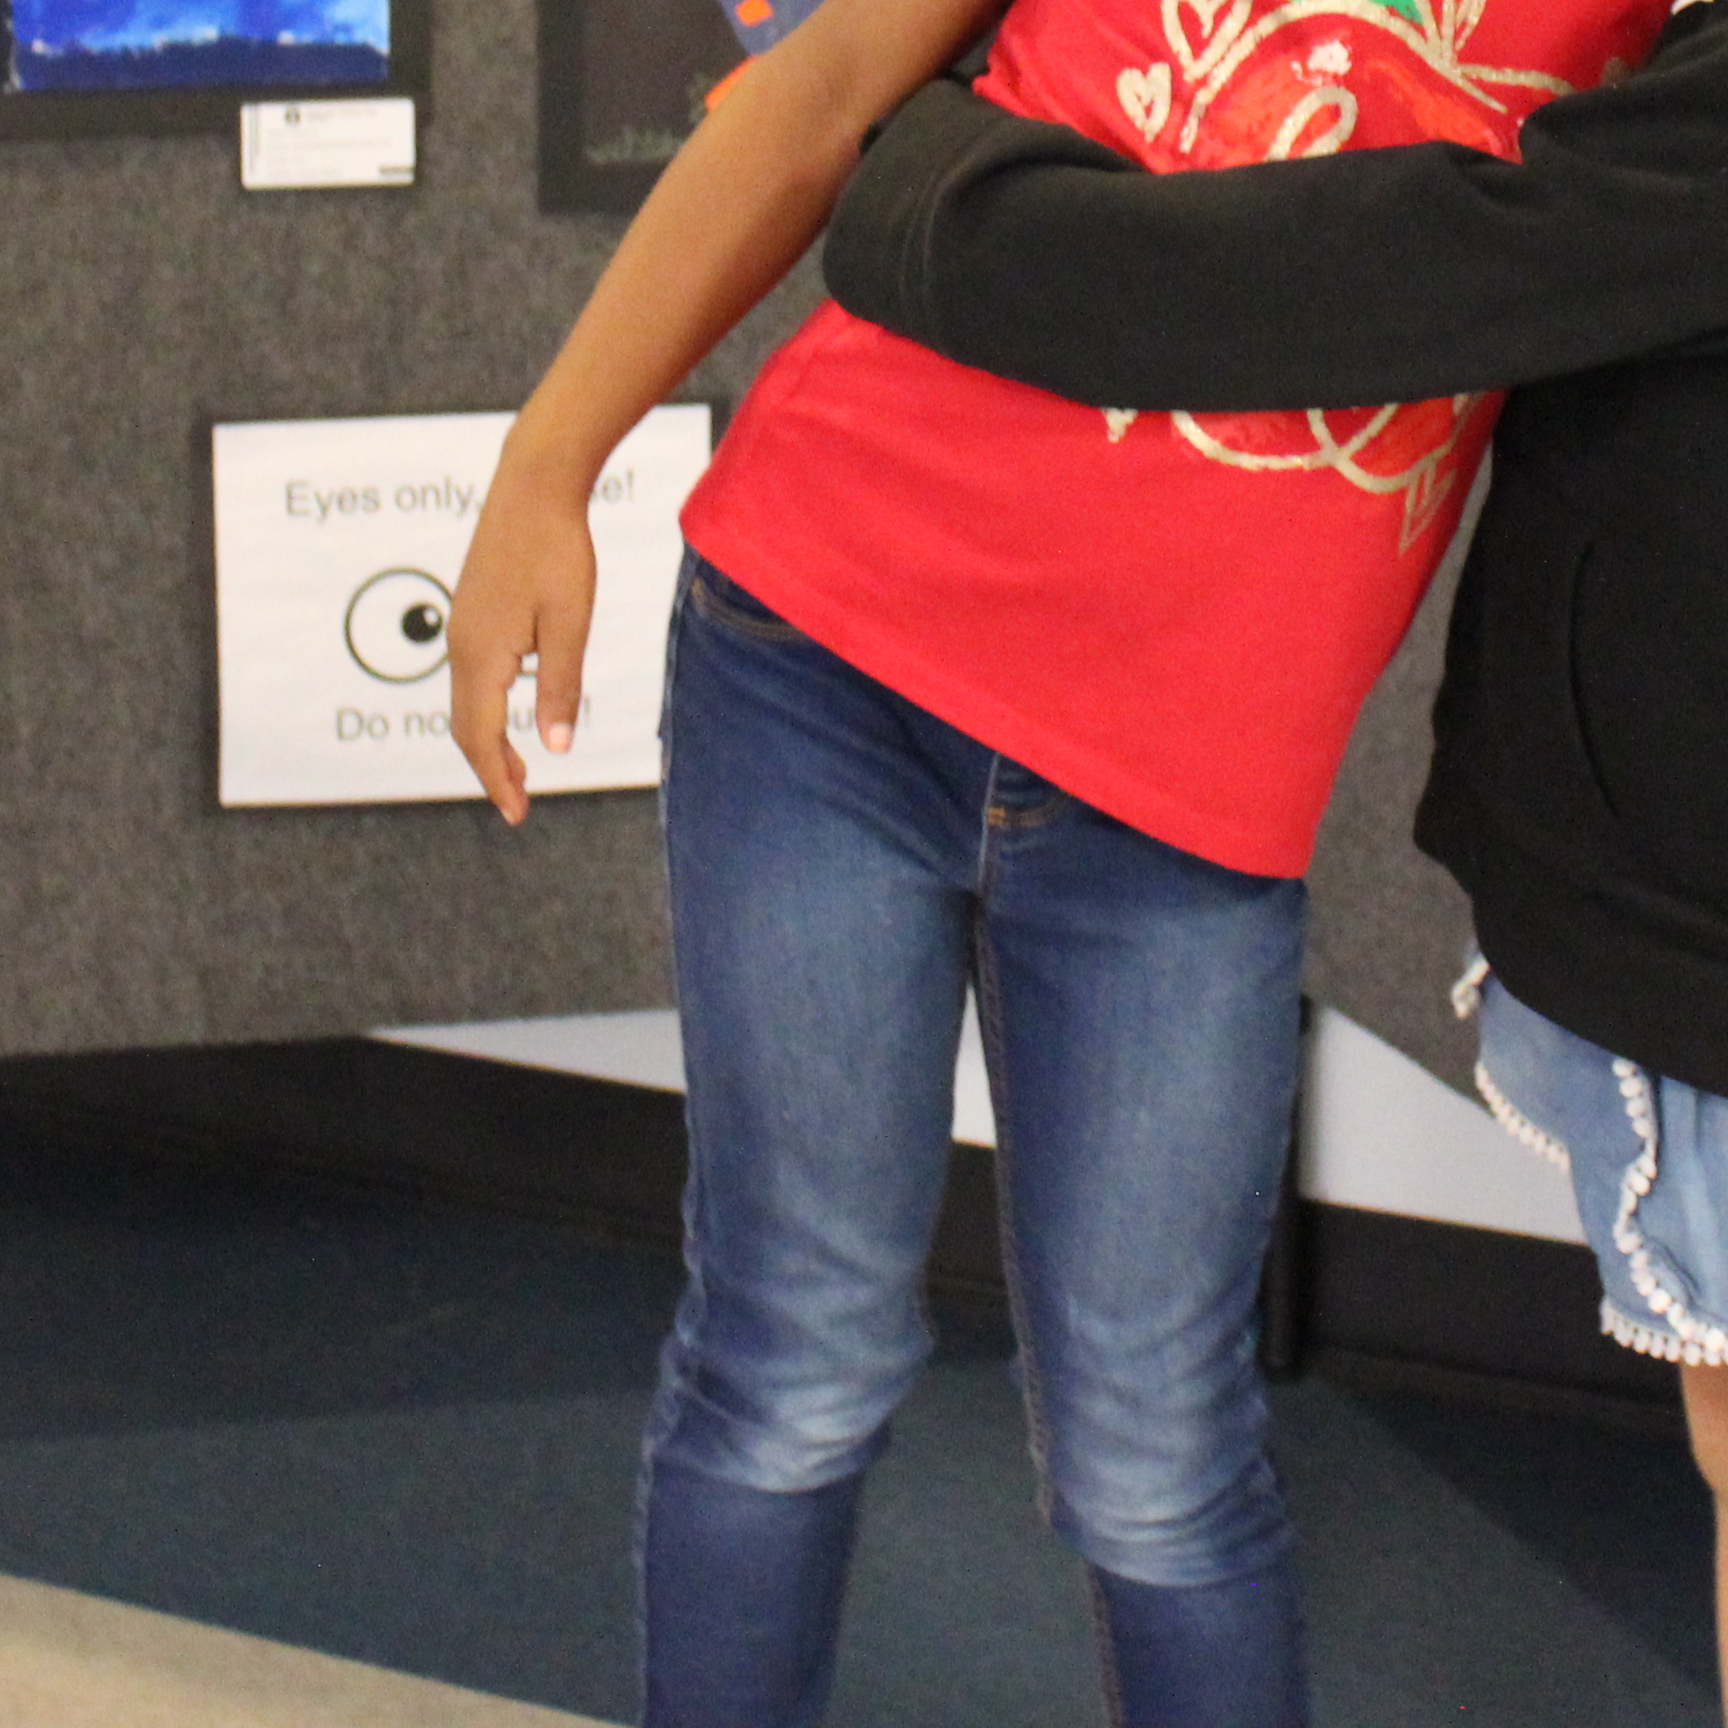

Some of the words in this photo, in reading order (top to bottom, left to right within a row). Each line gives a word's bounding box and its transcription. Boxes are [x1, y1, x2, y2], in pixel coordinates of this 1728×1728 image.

[285, 478, 381, 523] Eyes
[336, 706, 389, 740] Do
[404, 709, 451, 737] no
